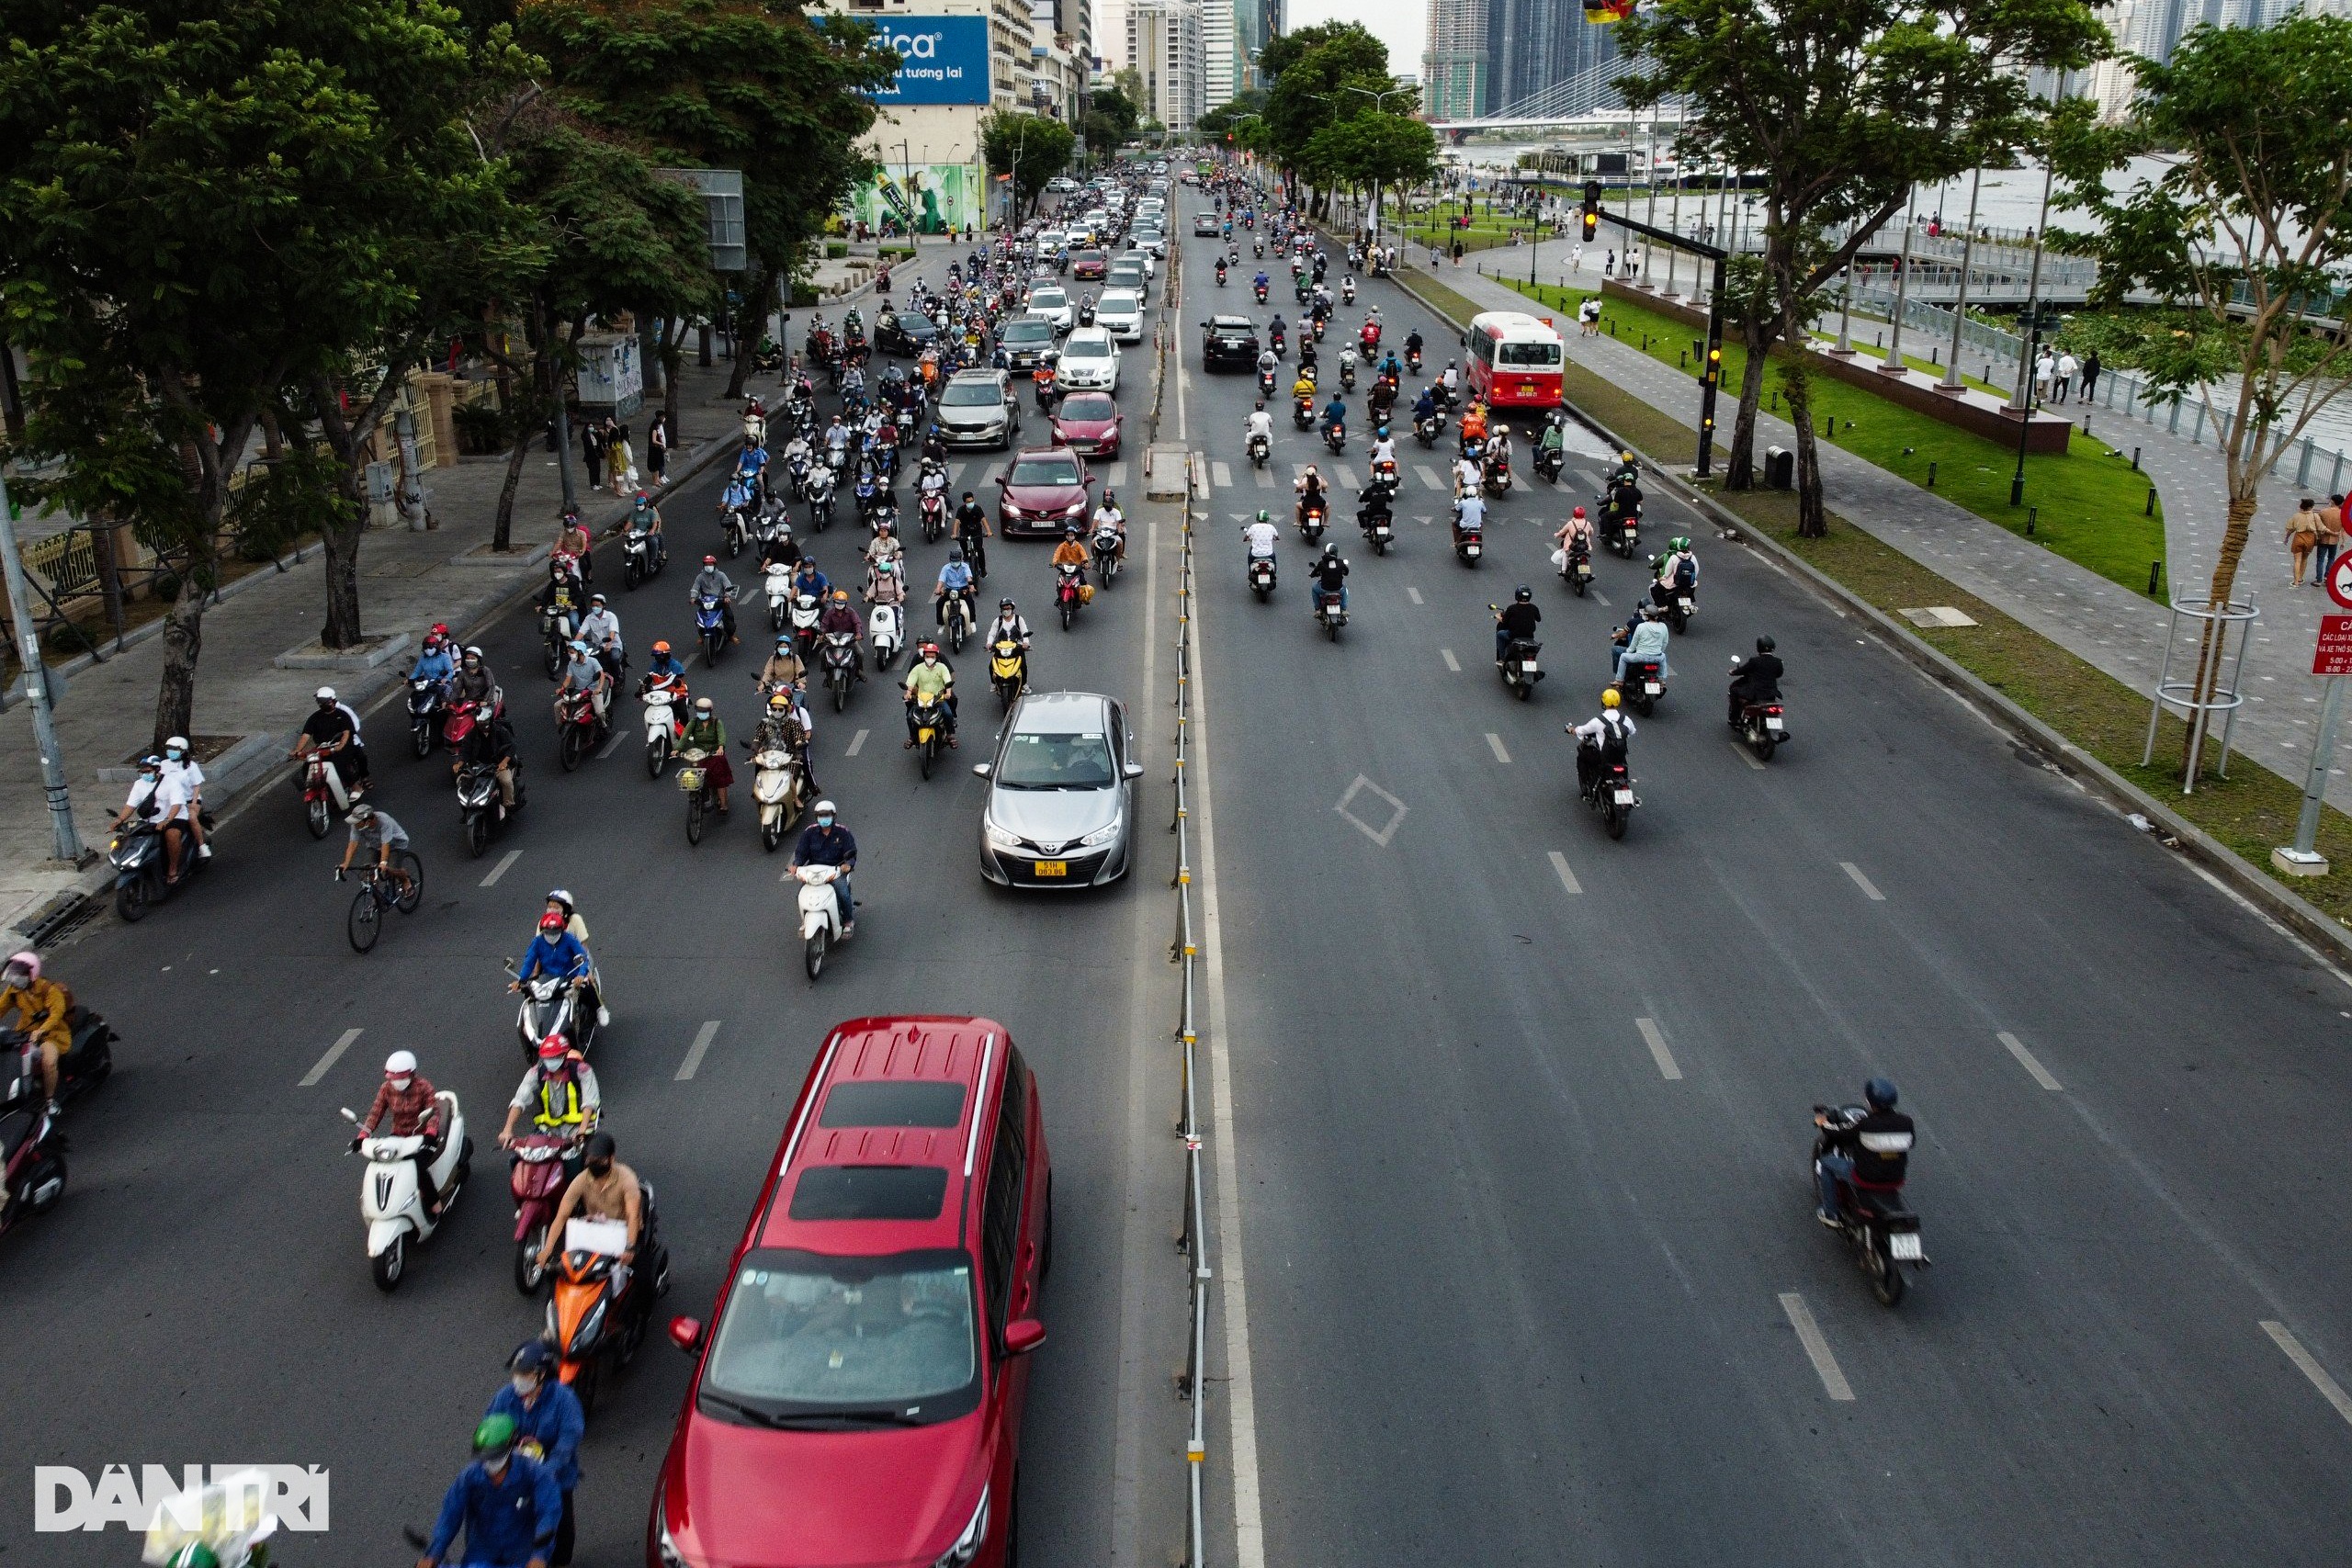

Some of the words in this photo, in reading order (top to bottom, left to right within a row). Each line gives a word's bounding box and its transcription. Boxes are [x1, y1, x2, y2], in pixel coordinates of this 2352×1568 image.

[905, 67, 943, 81] tương
[946, 66, 963, 78] lai
[2326, 645, 2335, 653] XE
